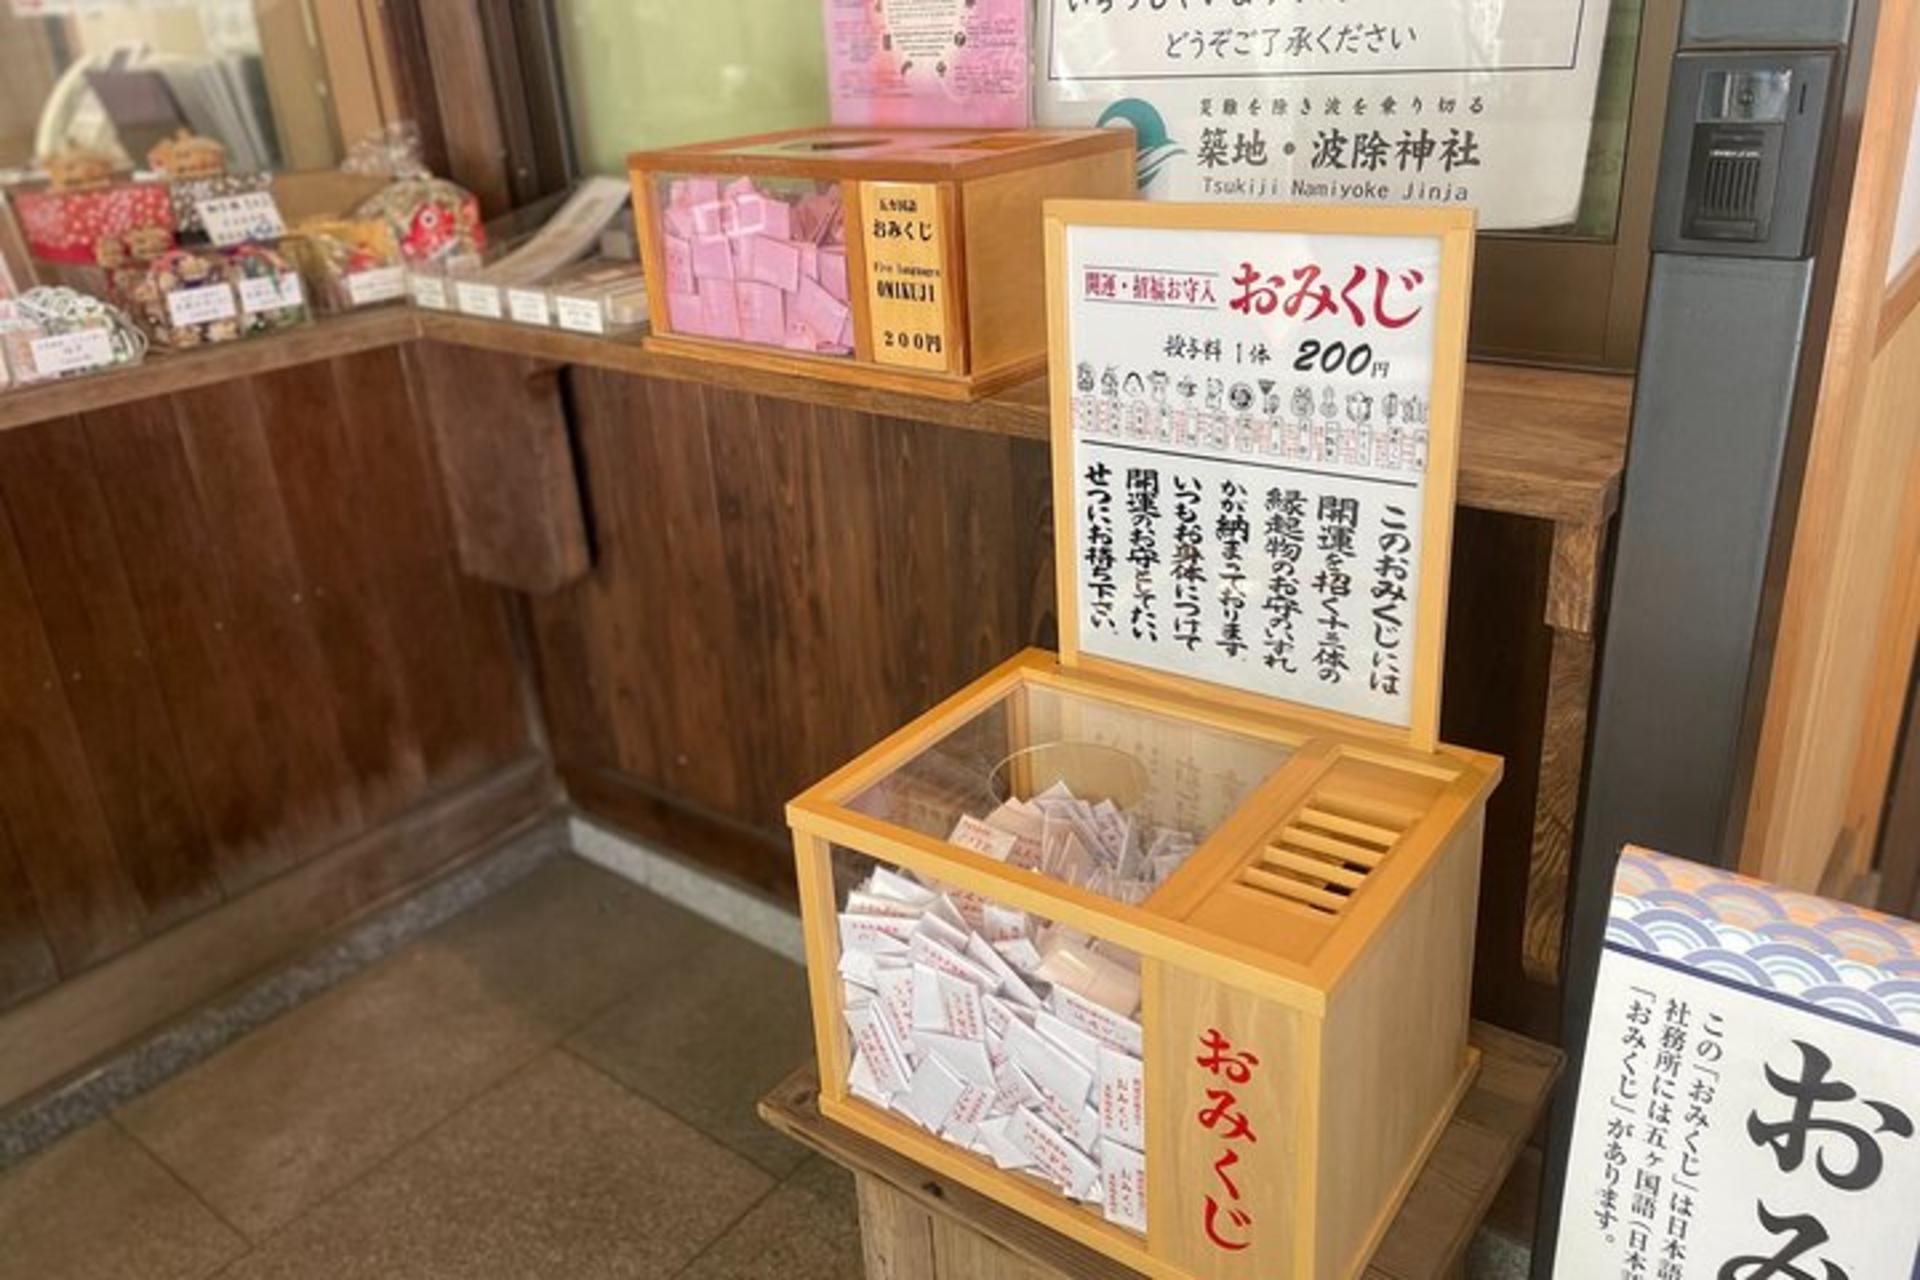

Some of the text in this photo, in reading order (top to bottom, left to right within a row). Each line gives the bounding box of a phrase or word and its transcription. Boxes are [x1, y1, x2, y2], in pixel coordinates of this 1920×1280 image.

[1166, 24, 1417, 58] どうぞご了承ください
[1199, 95, 1485, 117] 災難を除き波を乗り切る
[1202, 177, 1469, 201] Tsukiji Namiyoke Jinja
[872, 218, 932, 242] おみくじ
[1229, 262, 1425, 329] おみくじ
[884, 330, 942, 353] 200円
[1293, 338, 1391, 379] 200円
[1170, 474, 1208, 652] いつもお身体につけて
[1370, 505, 1412, 696] このおみくじには
[1195, 1028, 1260, 1252] おみくじ
[1594, 985, 1657, 1245] 「おみくじ」があります。
[1717, 1039, 1915, 1280] おみ
